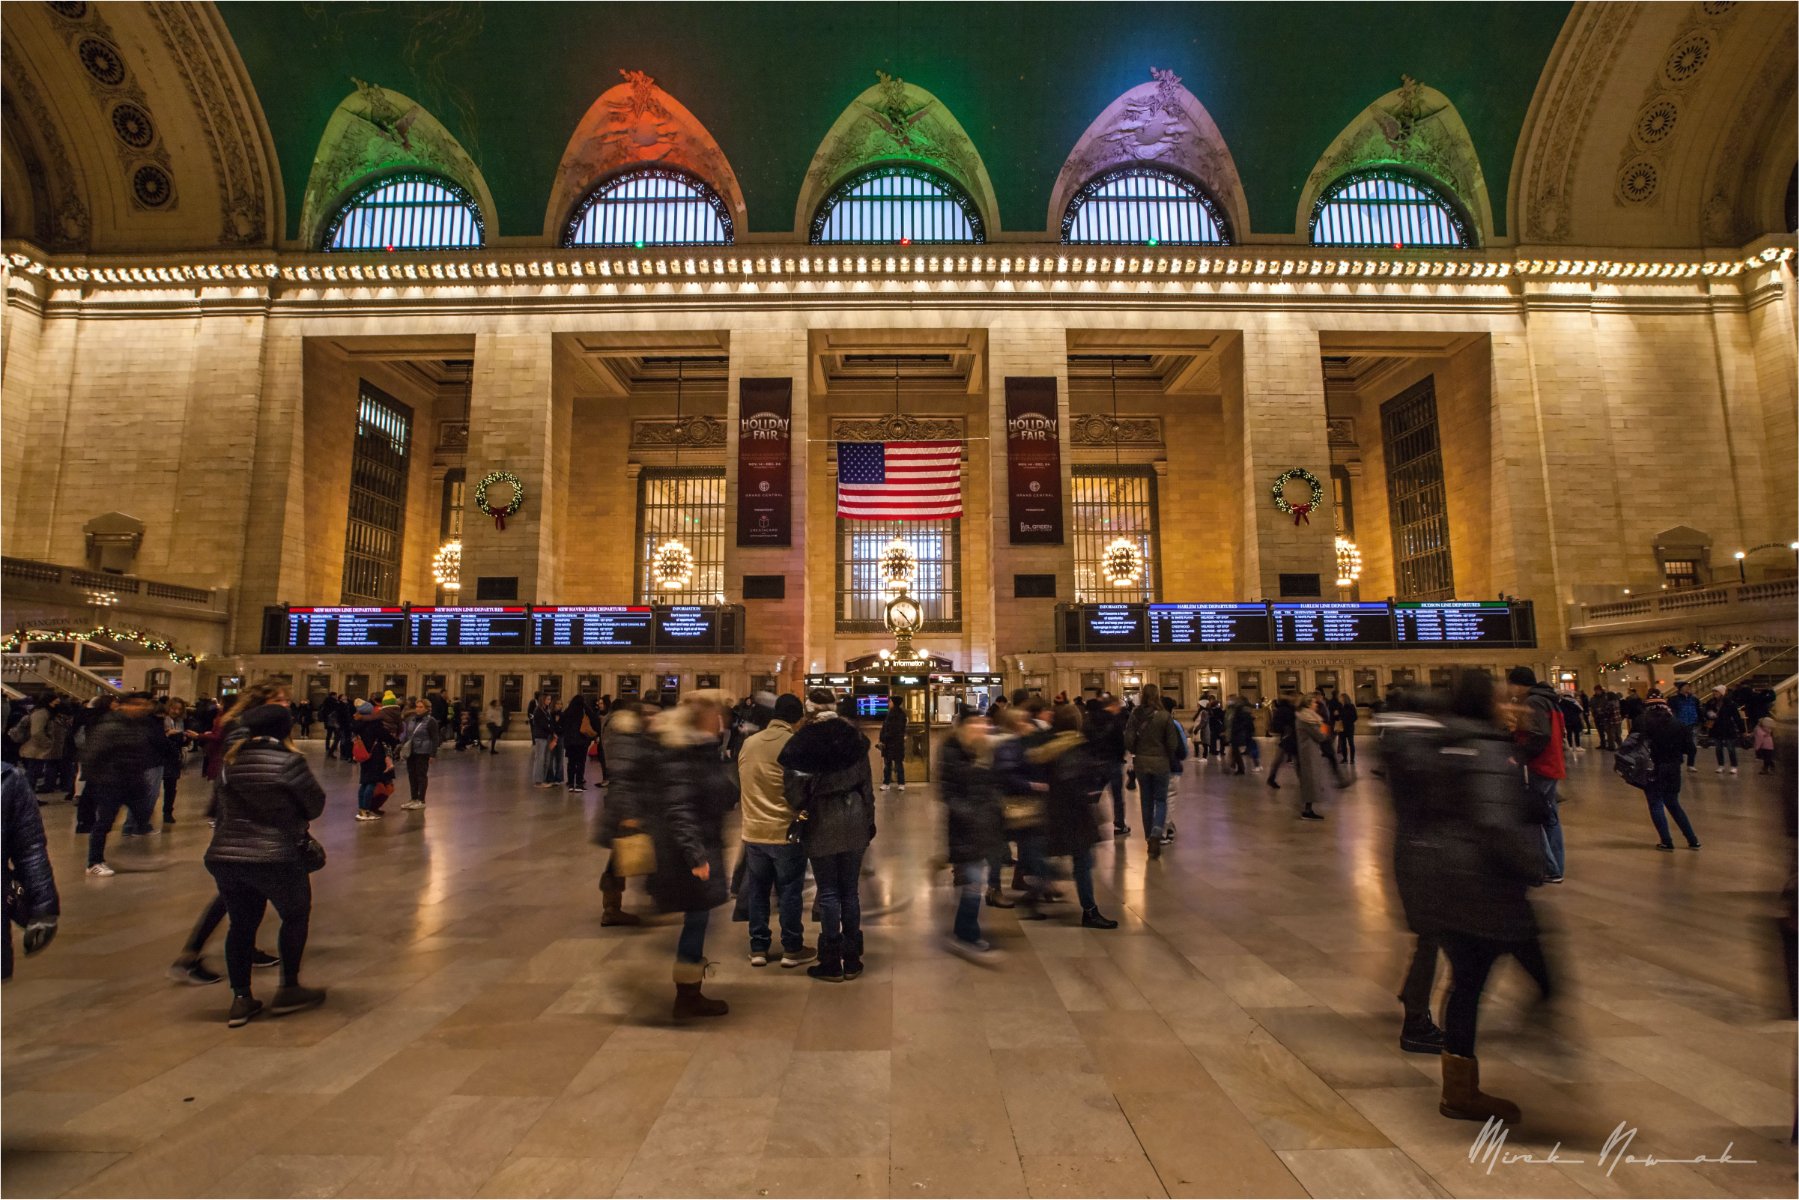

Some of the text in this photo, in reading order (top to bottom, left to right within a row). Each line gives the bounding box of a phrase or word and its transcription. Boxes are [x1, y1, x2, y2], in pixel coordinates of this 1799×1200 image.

[742, 419, 789, 431] HOLIDAY
[1009, 419, 1056, 431] HOLIDAY
[754, 431, 779, 440] FAIR
[1021, 431, 1046, 441] FAIR
[16, 618, 90, 628] LEXINGTON AVE
[1709, 634, 1744, 642] SUBWAY
